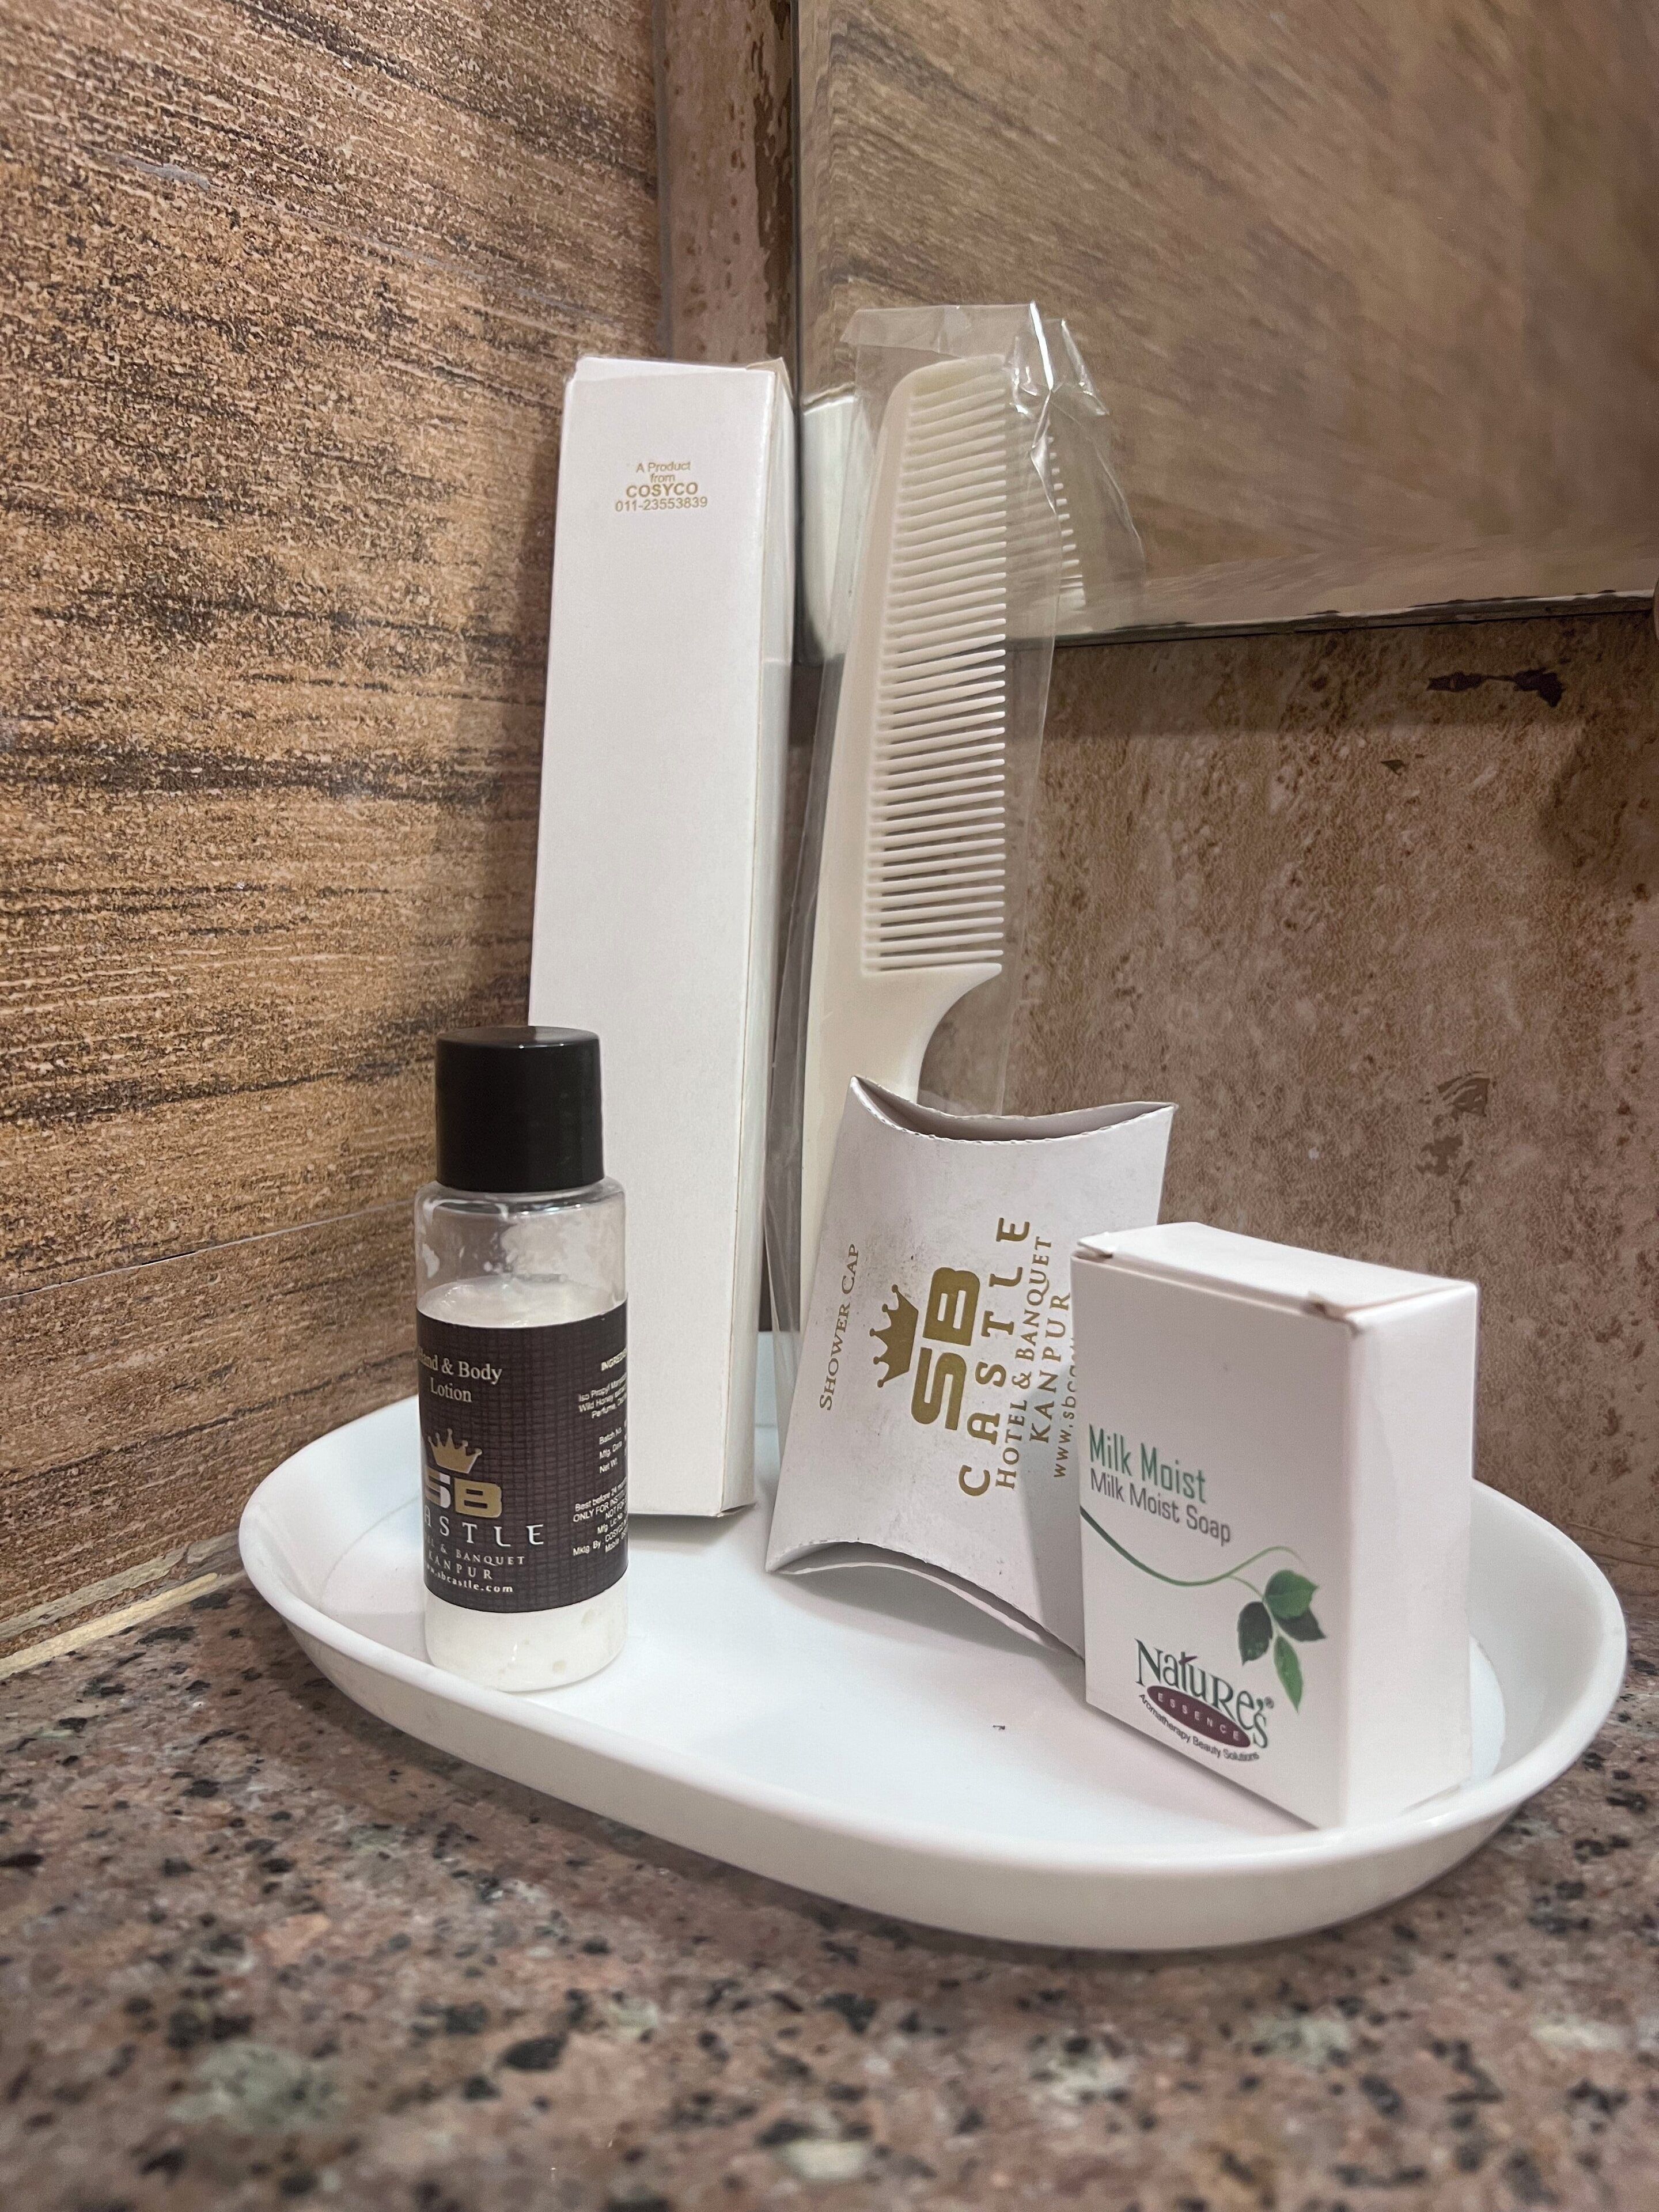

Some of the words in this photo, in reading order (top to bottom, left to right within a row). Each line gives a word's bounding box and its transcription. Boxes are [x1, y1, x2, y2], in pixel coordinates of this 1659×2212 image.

[626, 482, 699, 498] COSYCO
[636, 463, 645, 474] A
[648, 461, 691, 472] Product
[650, 473, 675, 483] from
[615, 496, 708, 512] 011-23553839
[1015, 1236, 1052, 1362] BANQUET
[819, 1302, 850, 1410] SHOWER
[842, 1244, 859, 1294] CAP
[911, 1267, 980, 1431] SB
[441, 1358, 454, 1375] &
[459, 1361, 502, 1385] Body
[959, 1217, 1030, 1497] CASTLE
[1029, 1292, 1071, 1443] KANPUR
[430, 1377, 472, 1403] Lotion
[1012, 1371, 1032, 1389] &
[1054, 1338, 1077, 1478] www.sbca
[995, 1400, 1027, 1489] HOTEL
[1089, 1423, 1133, 1476] Milk
[1141, 1442, 1206, 1503] Moist
[425, 1467, 503, 1518] SB
[573, 1509, 594, 1522] ONLY
[596, 1502, 609, 1515] FOR
[575, 1501, 592, 1512] Best
[1090, 1468, 1125, 1502] Milk
[1130, 1483, 1180, 1524] Moist
[1186, 1505, 1232, 1546] Soap
[424, 1505, 544, 1547] ASTLE
[429, 1550, 493, 1580] KANPUR
[456, 1549, 525, 1566] BANQUET
[1138, 1694, 1191, 1743] Aromatherapy
[1192, 1736, 1221, 1758] Beauty
[1158, 1692, 1240, 1741] ESSENCE
